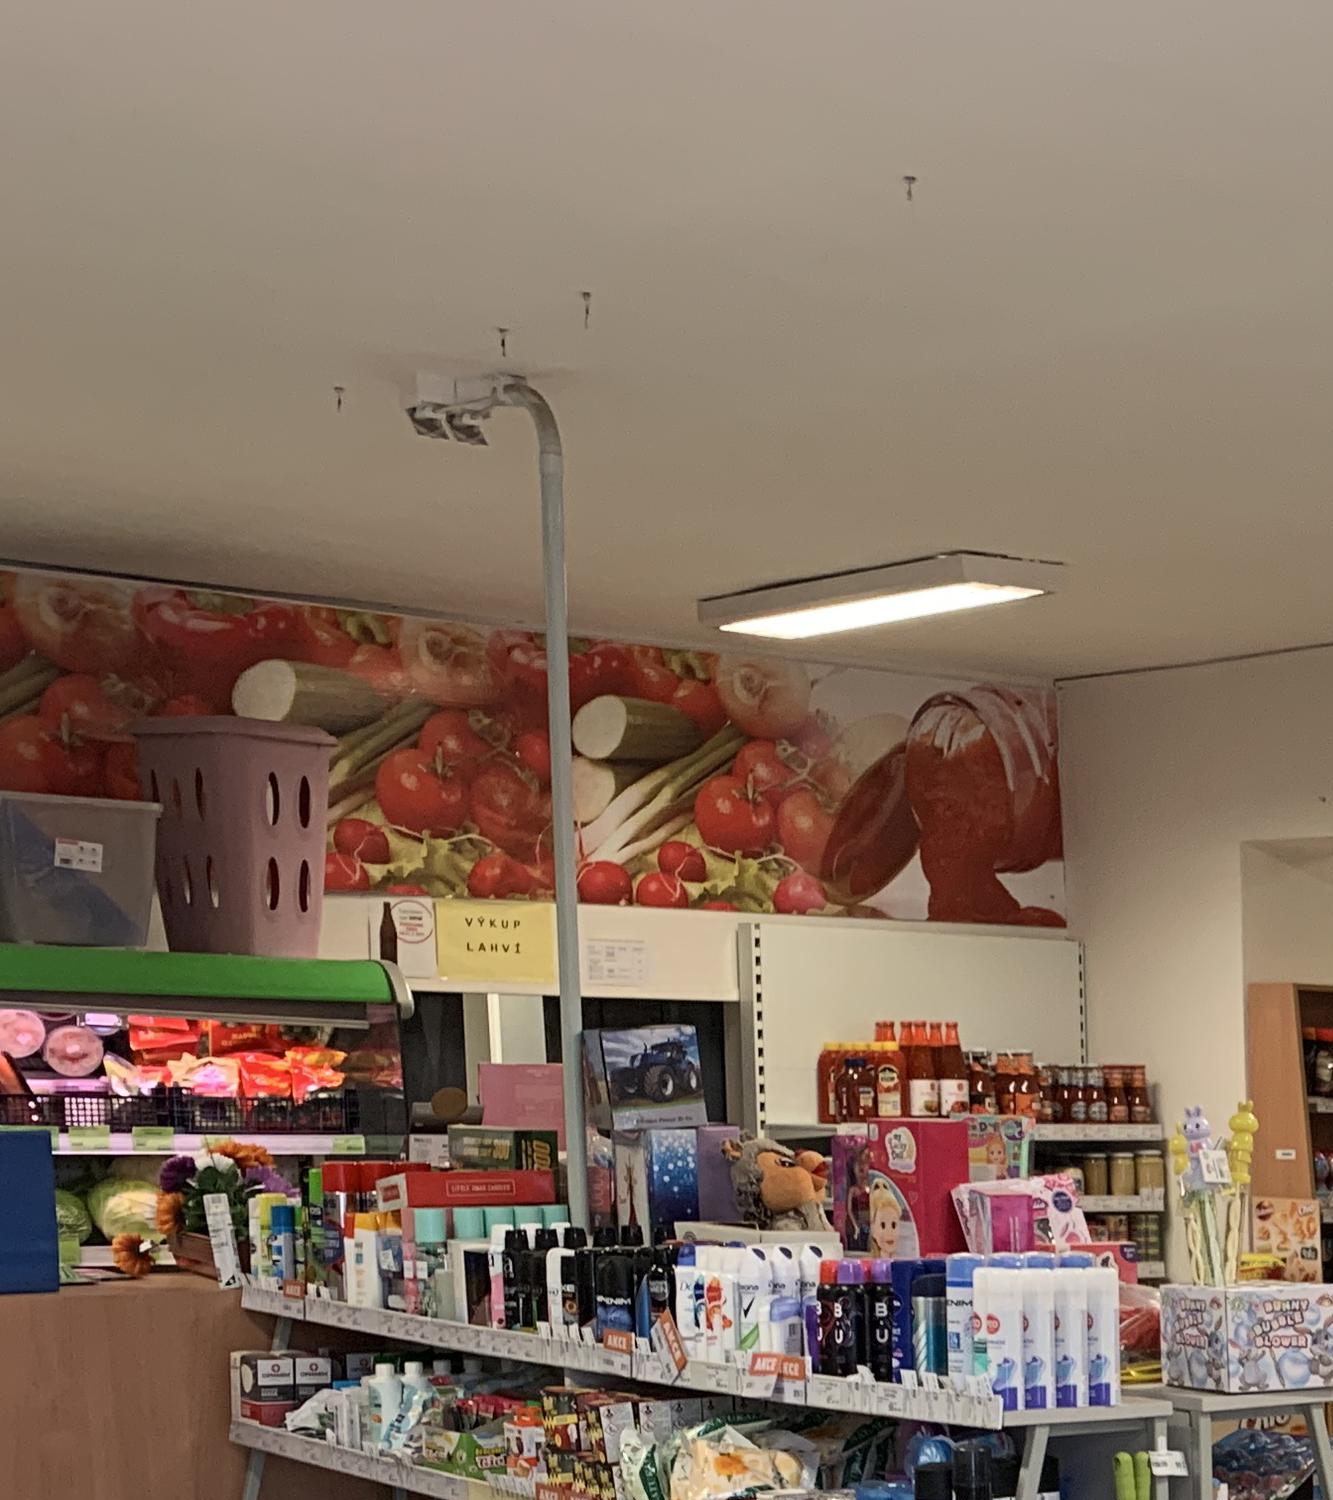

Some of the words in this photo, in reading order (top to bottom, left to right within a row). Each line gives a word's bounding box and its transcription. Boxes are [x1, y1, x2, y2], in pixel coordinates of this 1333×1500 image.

[465, 916, 522, 930] VÝKUP
[466, 941, 522, 955] LAHVÍ
[607, 1334, 628, 1348] AKCE
[663, 1319, 682, 1360] AKCE
[1254, 1333, 1309, 1348] BLOWER
[753, 1357, 776, 1372] AKCE
